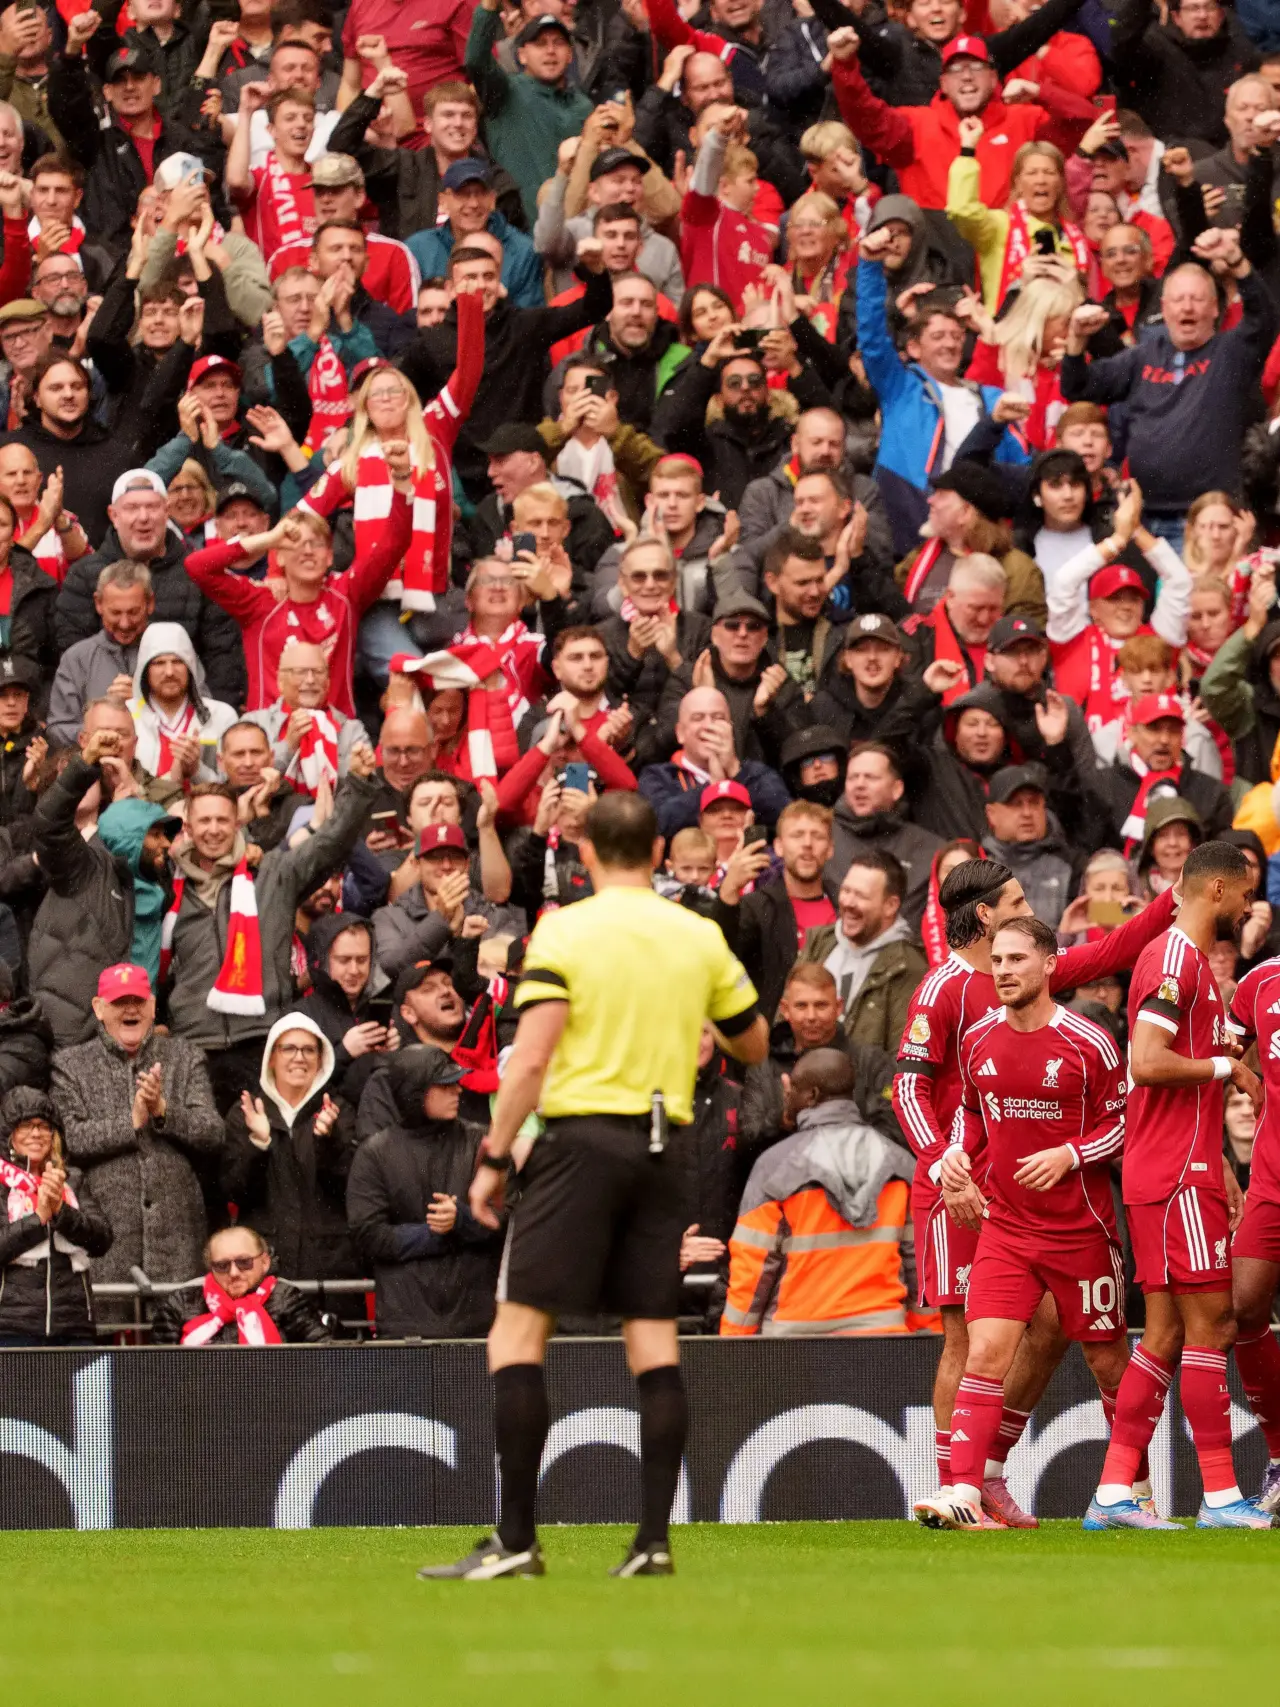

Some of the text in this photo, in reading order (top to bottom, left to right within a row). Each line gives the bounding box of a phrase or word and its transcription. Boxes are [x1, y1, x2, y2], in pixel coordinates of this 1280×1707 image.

[1003, 1096, 1059, 1109] standard
[1004, 1107, 1063, 1120] chartered
[1078, 1276, 1116, 1314] 10
